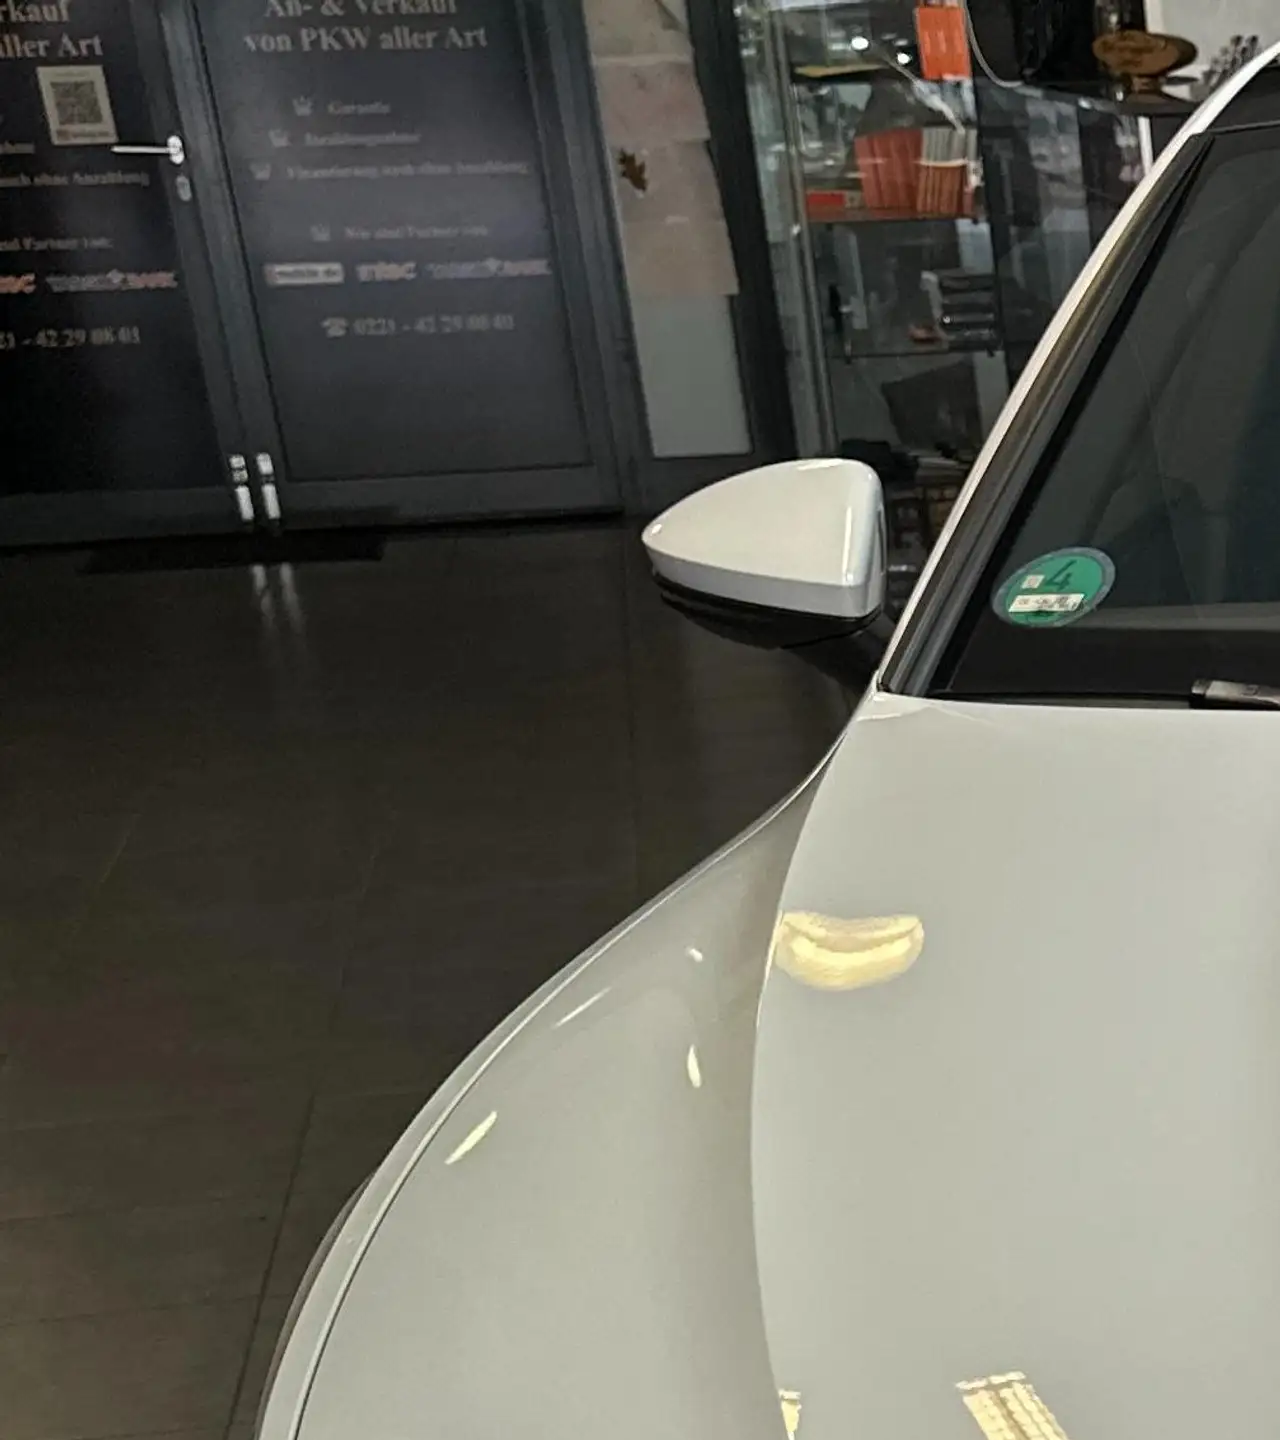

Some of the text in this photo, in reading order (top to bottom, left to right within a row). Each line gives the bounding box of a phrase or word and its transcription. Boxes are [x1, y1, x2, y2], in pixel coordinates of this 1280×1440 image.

[58, 32, 104, 57] Art
[243, 25, 488, 52] von PKW aller Art
[1045, 560, 1078, 590] 4
